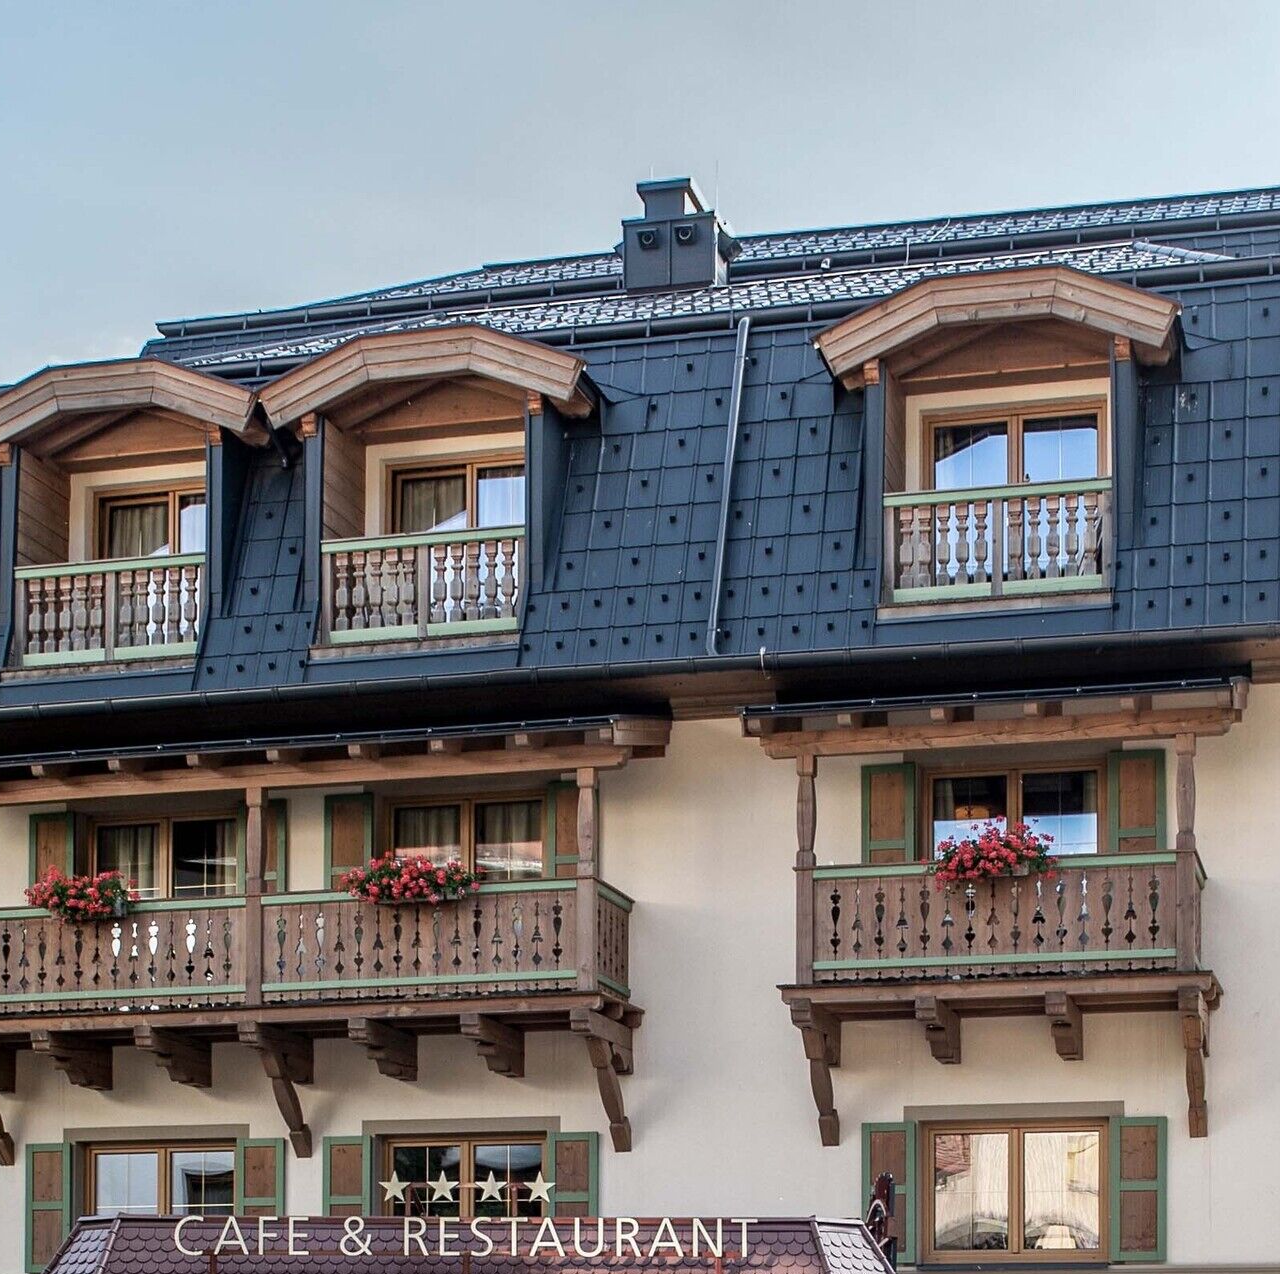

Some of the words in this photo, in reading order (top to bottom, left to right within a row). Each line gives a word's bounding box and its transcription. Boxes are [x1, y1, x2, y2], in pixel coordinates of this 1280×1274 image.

[174, 1215, 309, 1257] CAFE
[339, 1216, 373, 1257] &
[403, 1216, 758, 1259] RESTAURANT
